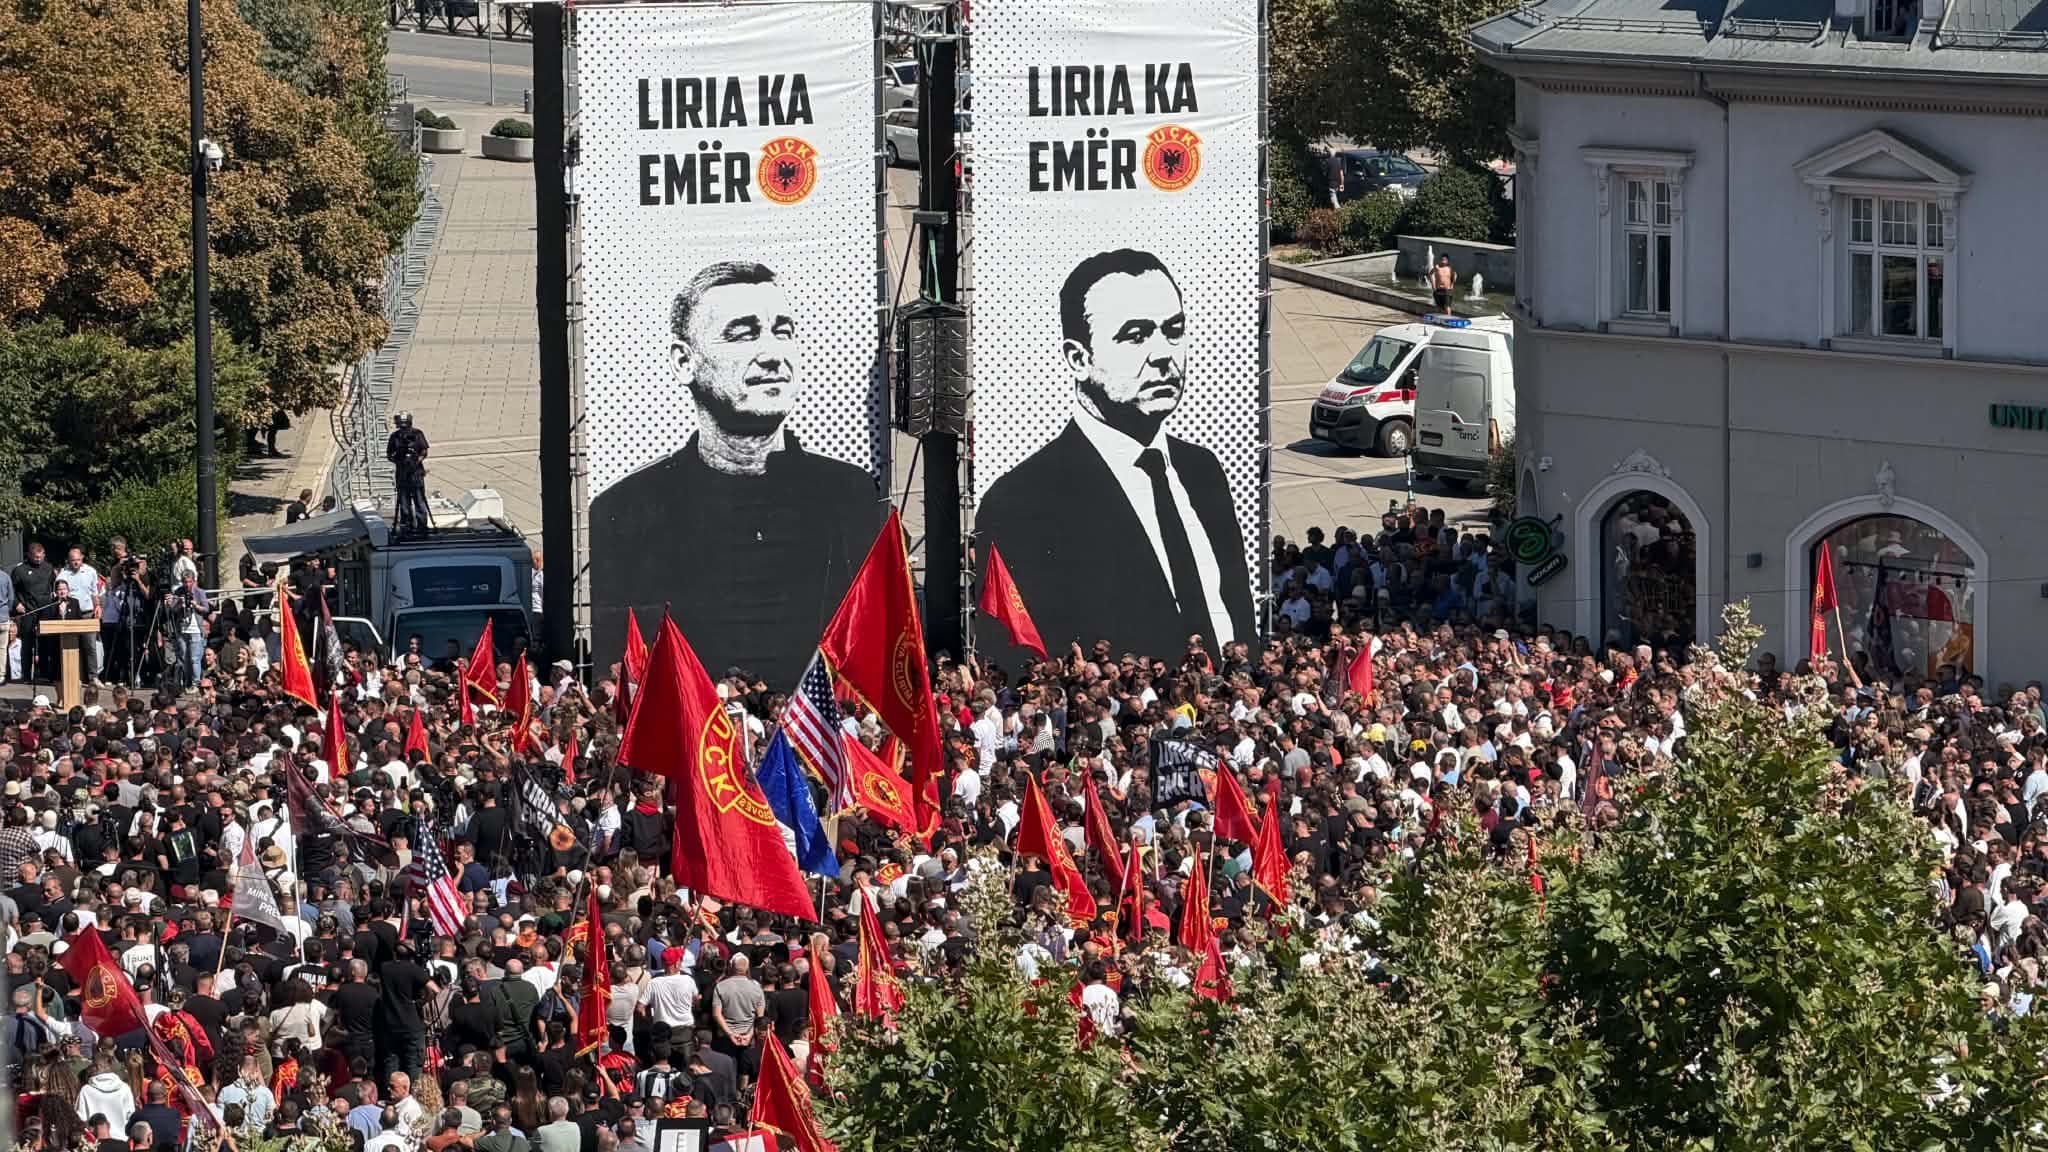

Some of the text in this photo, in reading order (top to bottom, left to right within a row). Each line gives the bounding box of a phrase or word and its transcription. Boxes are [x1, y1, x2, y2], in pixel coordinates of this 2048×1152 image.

[638, 74, 814, 130] LIRIA KA
[1028, 63, 1199, 117] LIRIA KA
[639, 140, 752, 206] EMËR
[1029, 127, 1137, 192] EMËR
